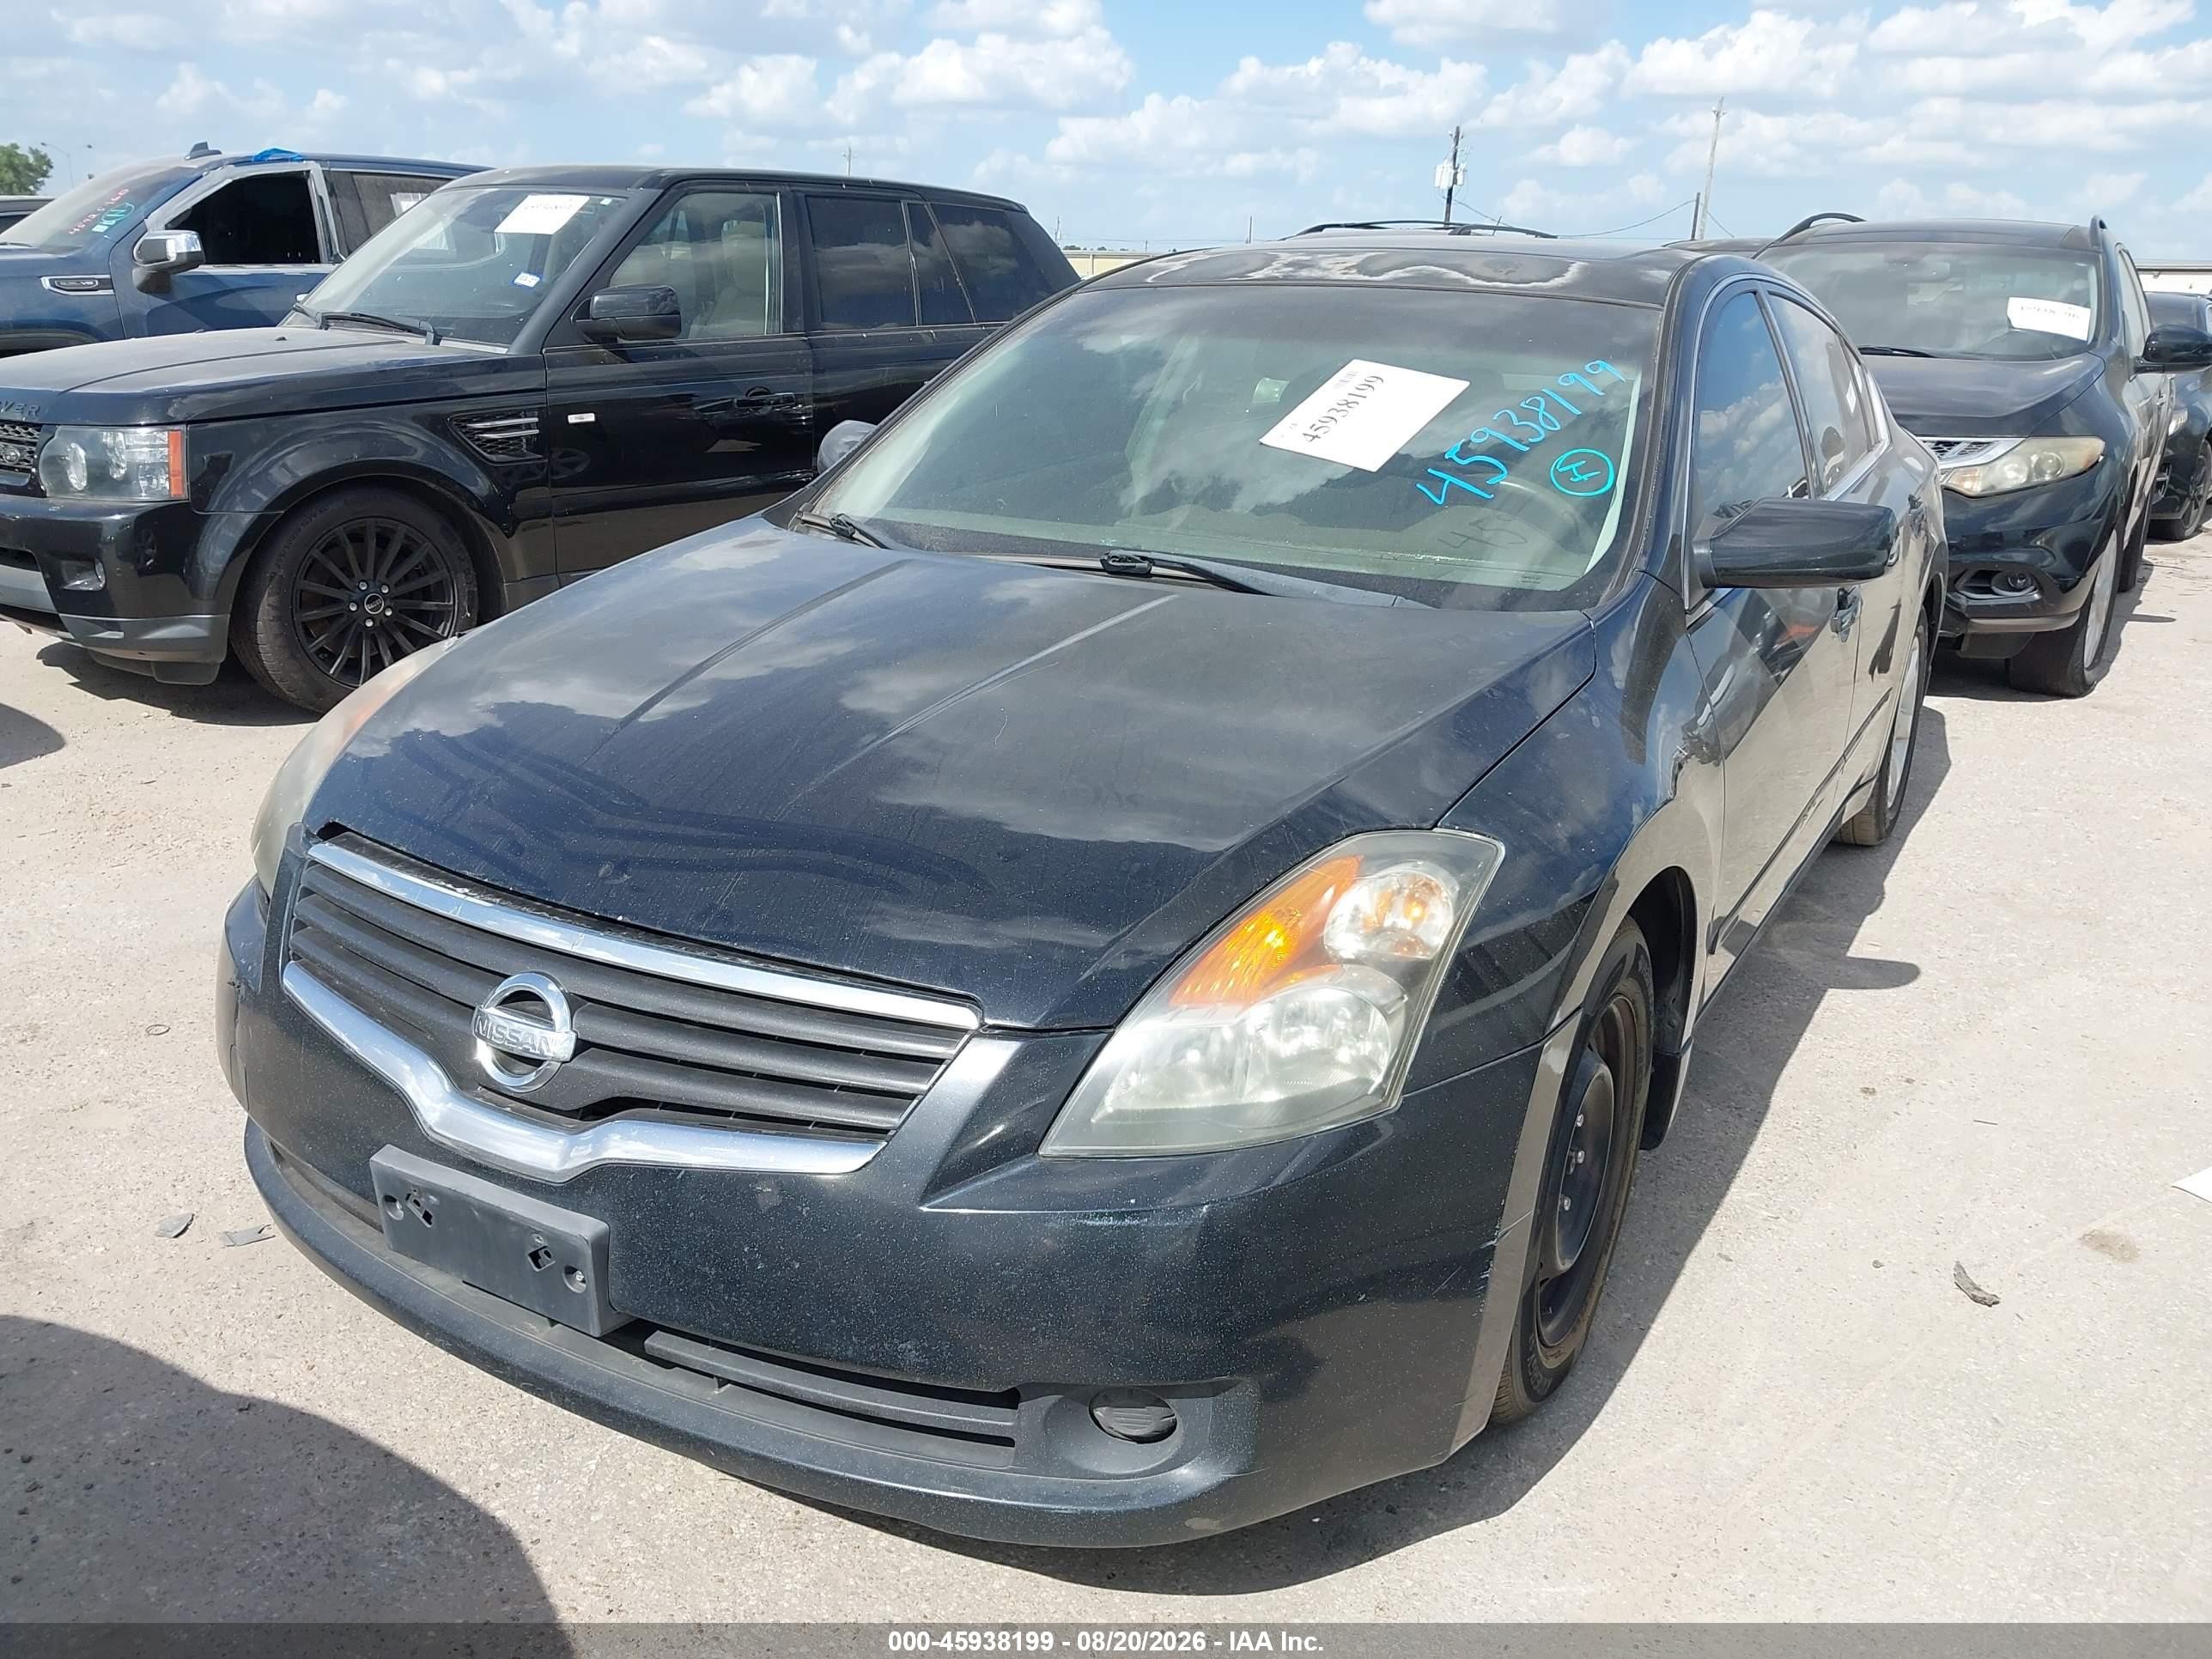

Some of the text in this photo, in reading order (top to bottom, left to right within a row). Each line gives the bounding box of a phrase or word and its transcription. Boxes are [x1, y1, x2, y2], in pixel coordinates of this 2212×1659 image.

[0, 398, 41, 416] VER
[1303, 375, 1384, 442] 45938199
[1416, 359, 1626, 505] 45938199
[474, 1014, 553, 1055] NISSAN
